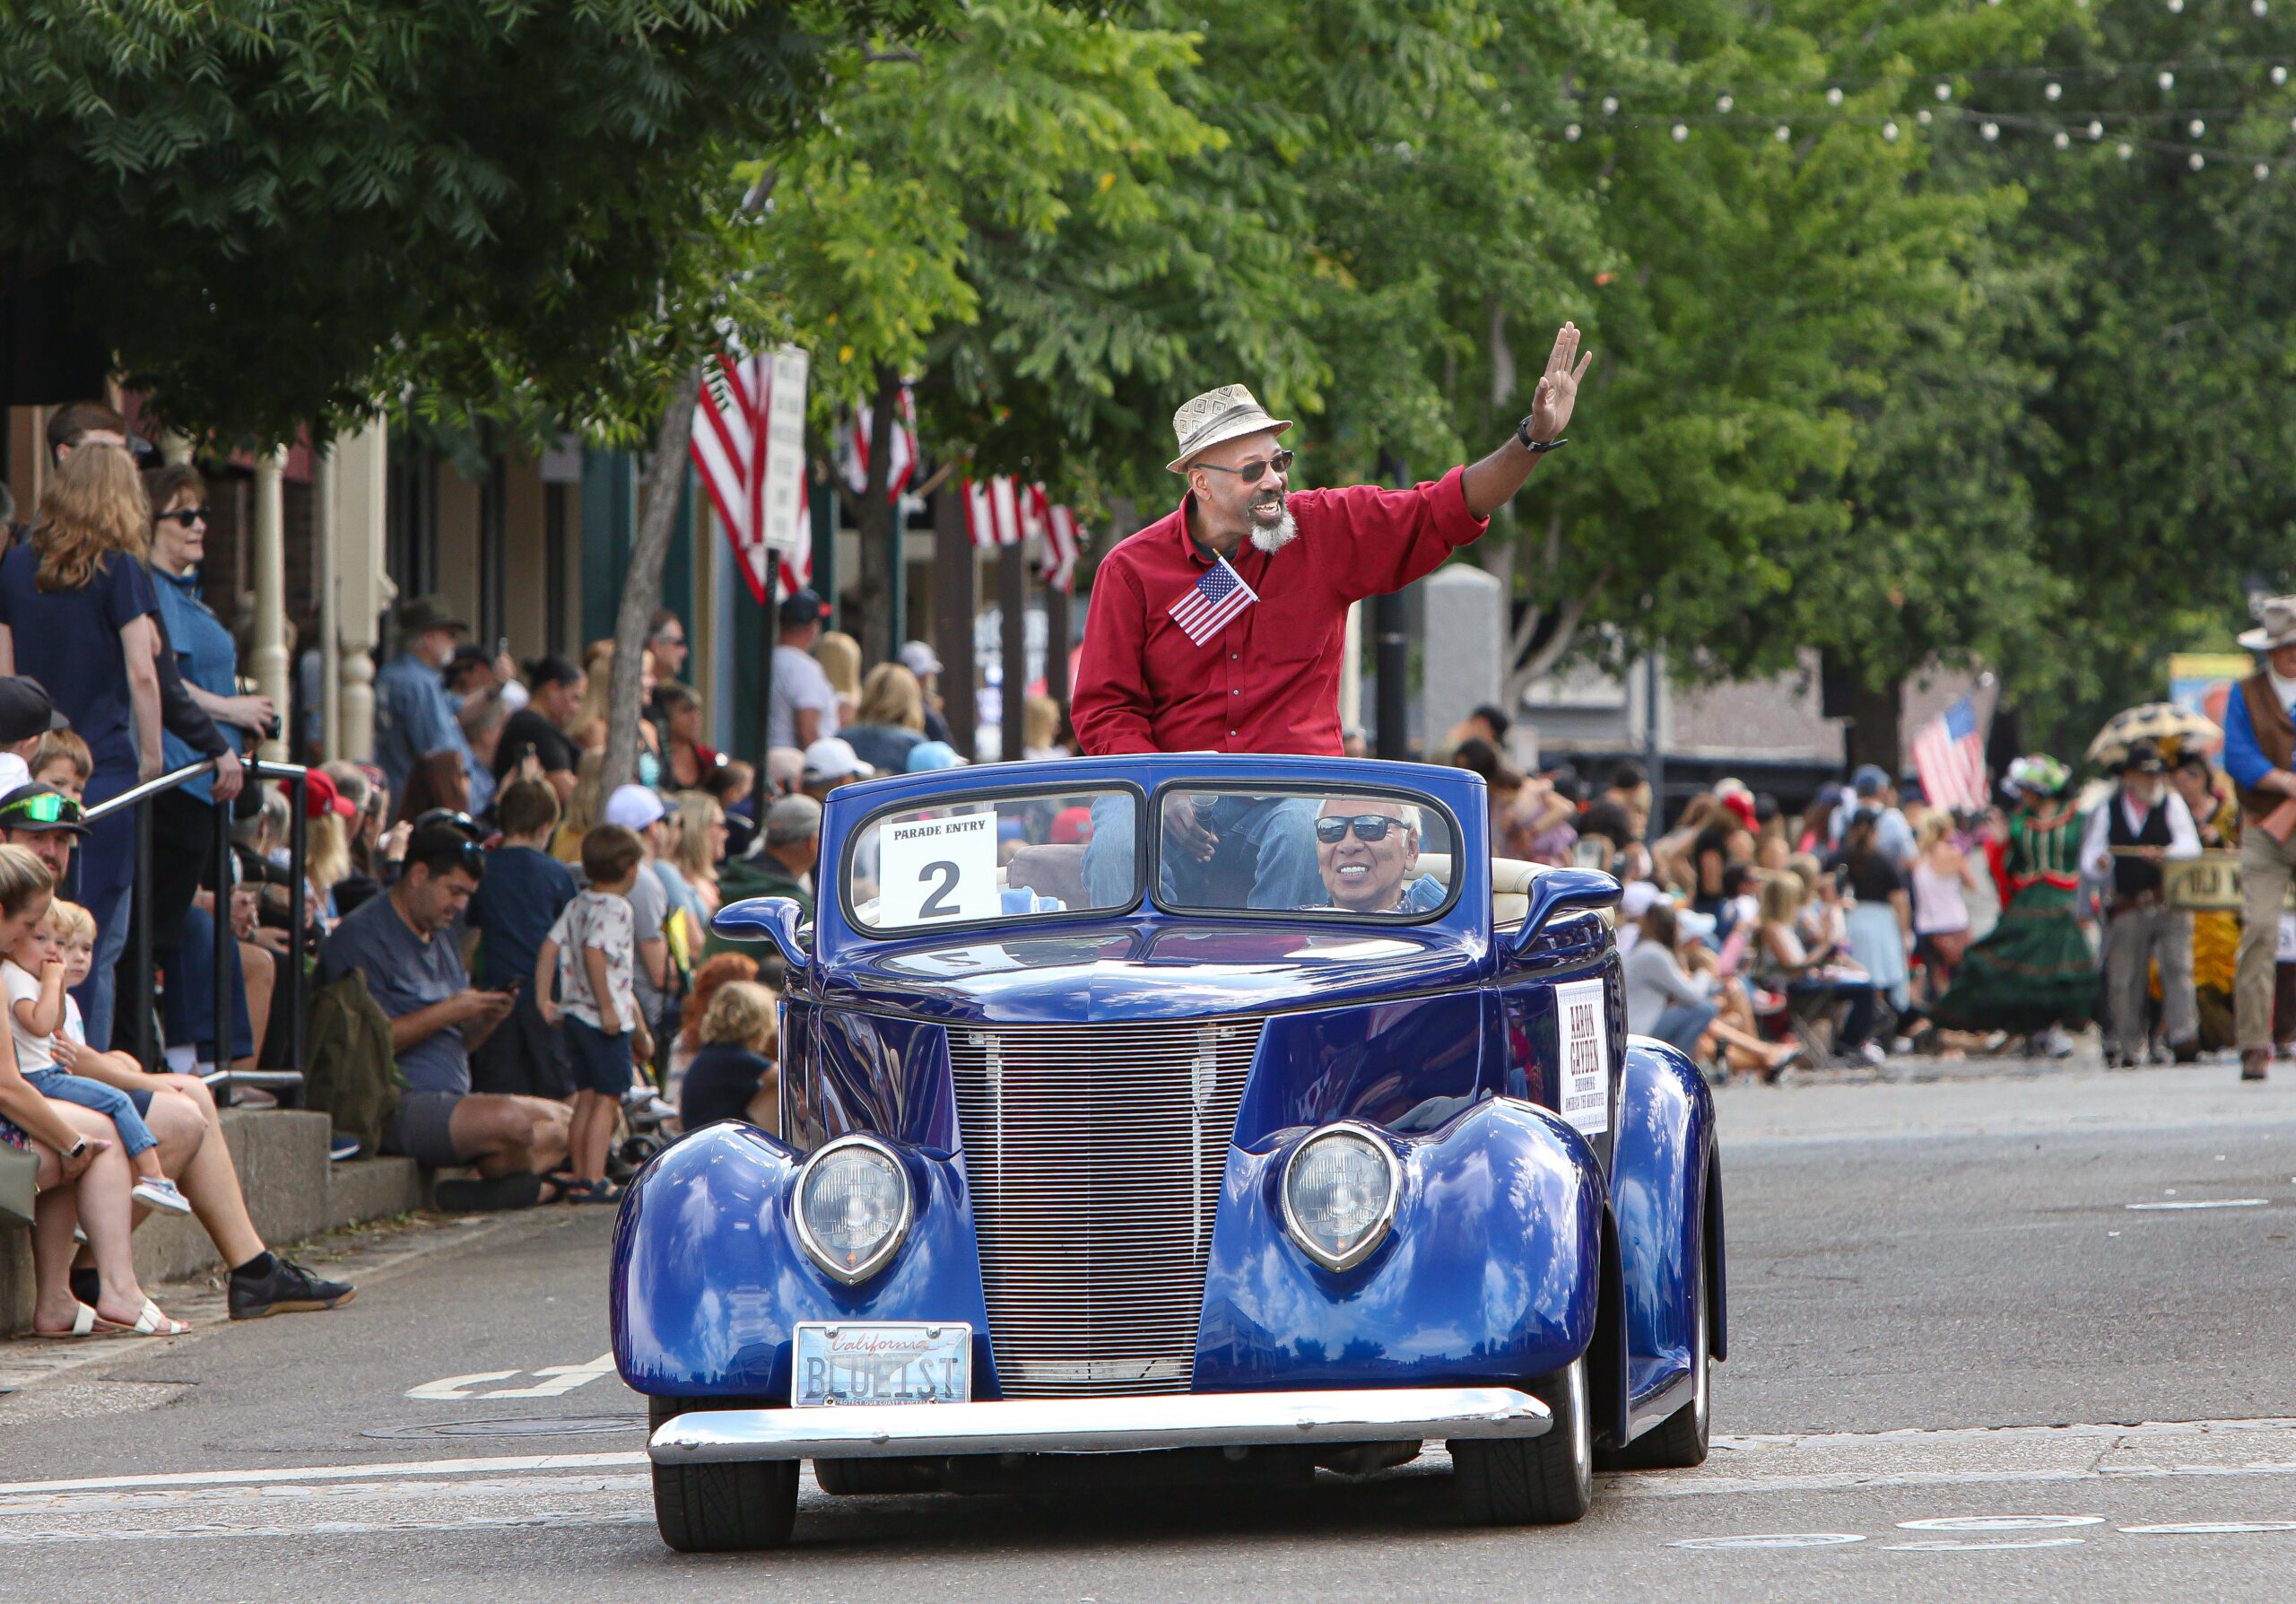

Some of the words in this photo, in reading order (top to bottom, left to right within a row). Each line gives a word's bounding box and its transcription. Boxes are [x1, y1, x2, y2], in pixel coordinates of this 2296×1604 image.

[893, 825, 942, 841] PARADE
[945, 820, 986, 834] ENTRY
[918, 860, 961, 920] 2
[1570, 1004, 1595, 1040] AARON
[1570, 1039, 1599, 1076] GAYDEN
[831, 1332, 938, 1356] California
